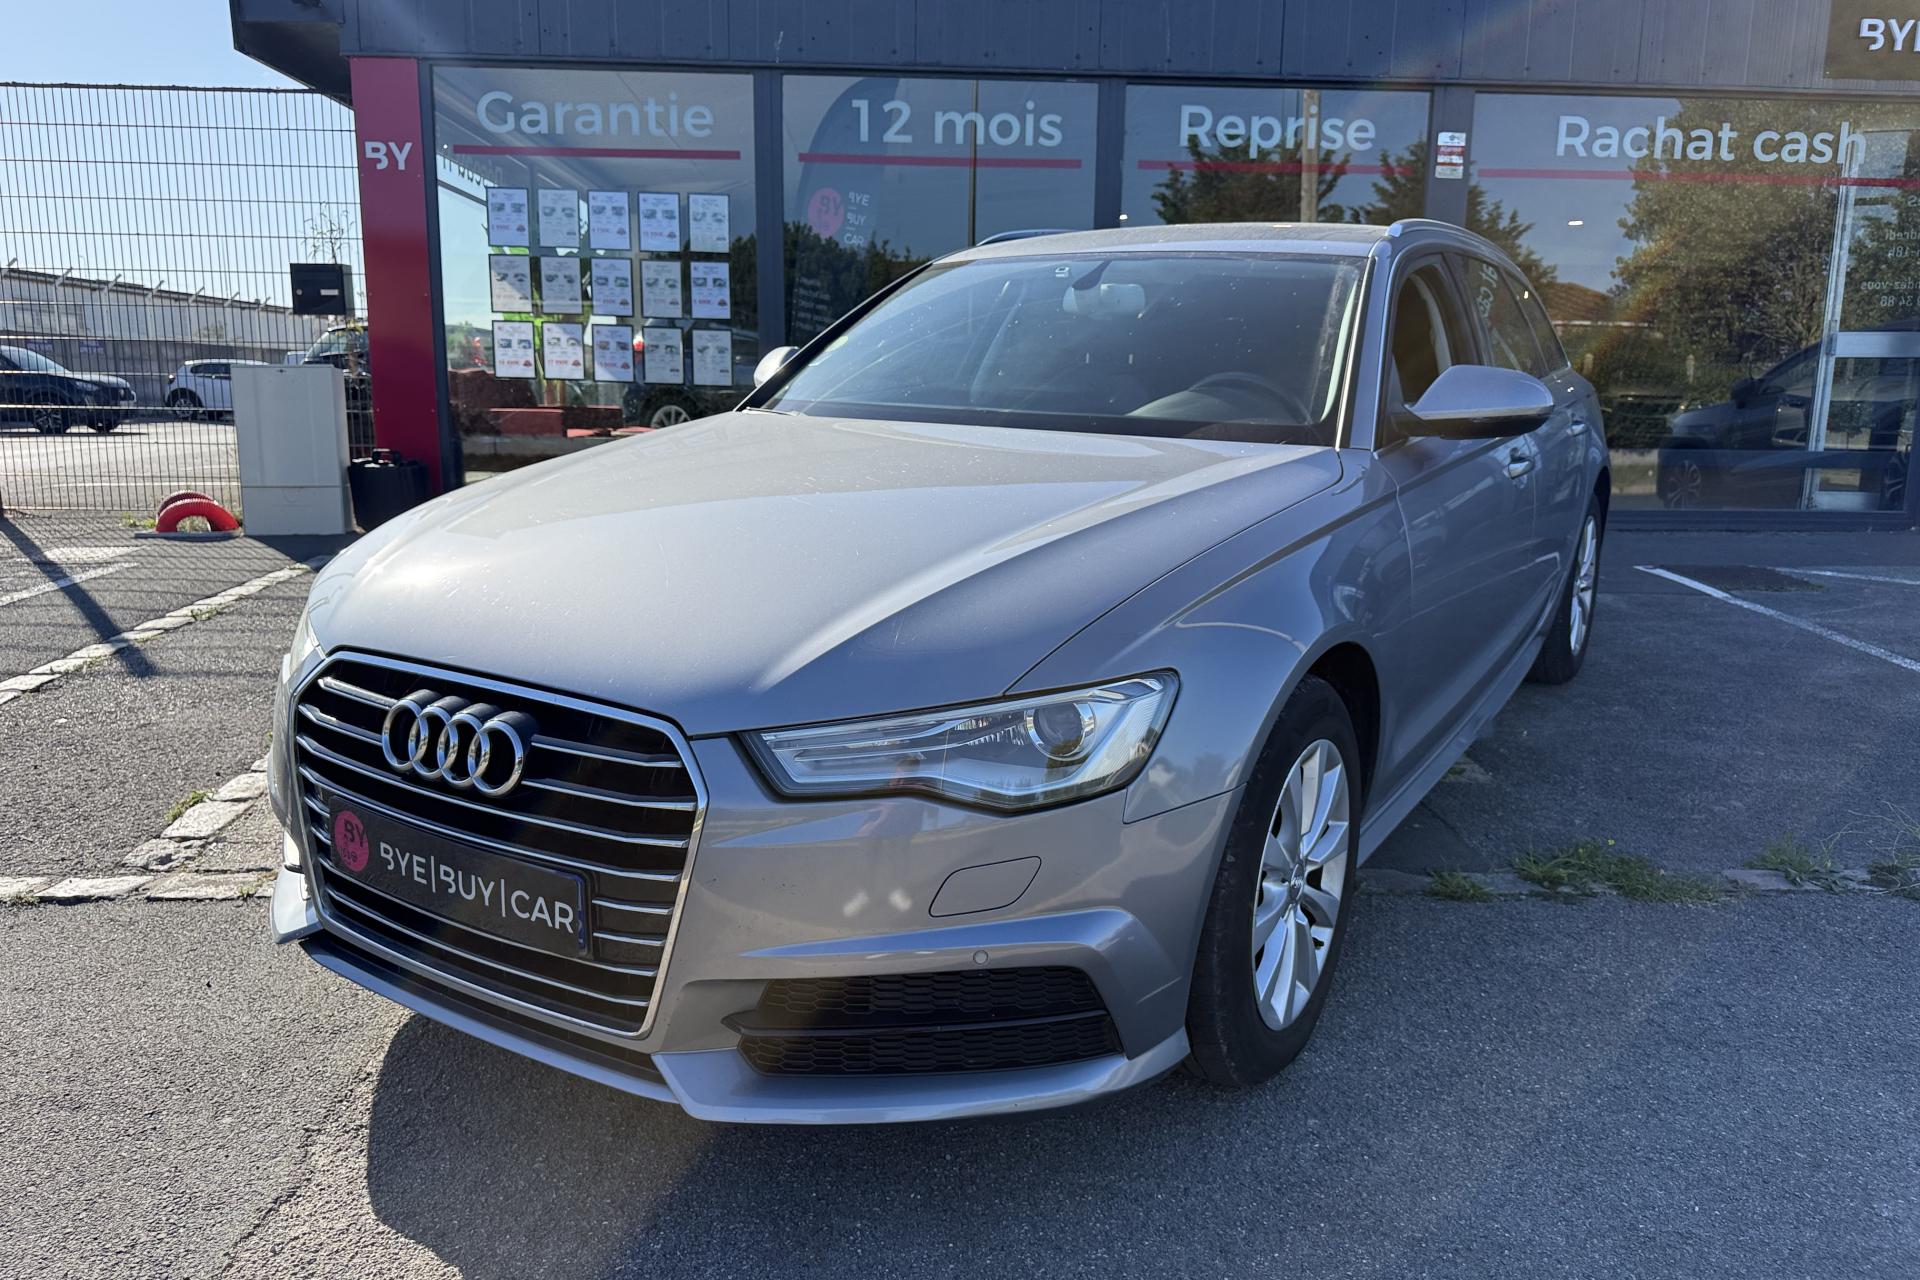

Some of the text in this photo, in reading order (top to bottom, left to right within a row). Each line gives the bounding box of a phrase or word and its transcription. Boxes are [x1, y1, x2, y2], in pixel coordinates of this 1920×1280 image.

[476, 91, 715, 138] Garantie
[851, 99, 1063, 148] 12 mois
[1179, 104, 1376, 160] Reprise
[364, 141, 413, 171] BY
[1556, 115, 1867, 165] Rachat cash
[848, 191, 871, 207] BYE
[847, 212, 866, 226] BUY
[344, 819, 367, 848] BY
